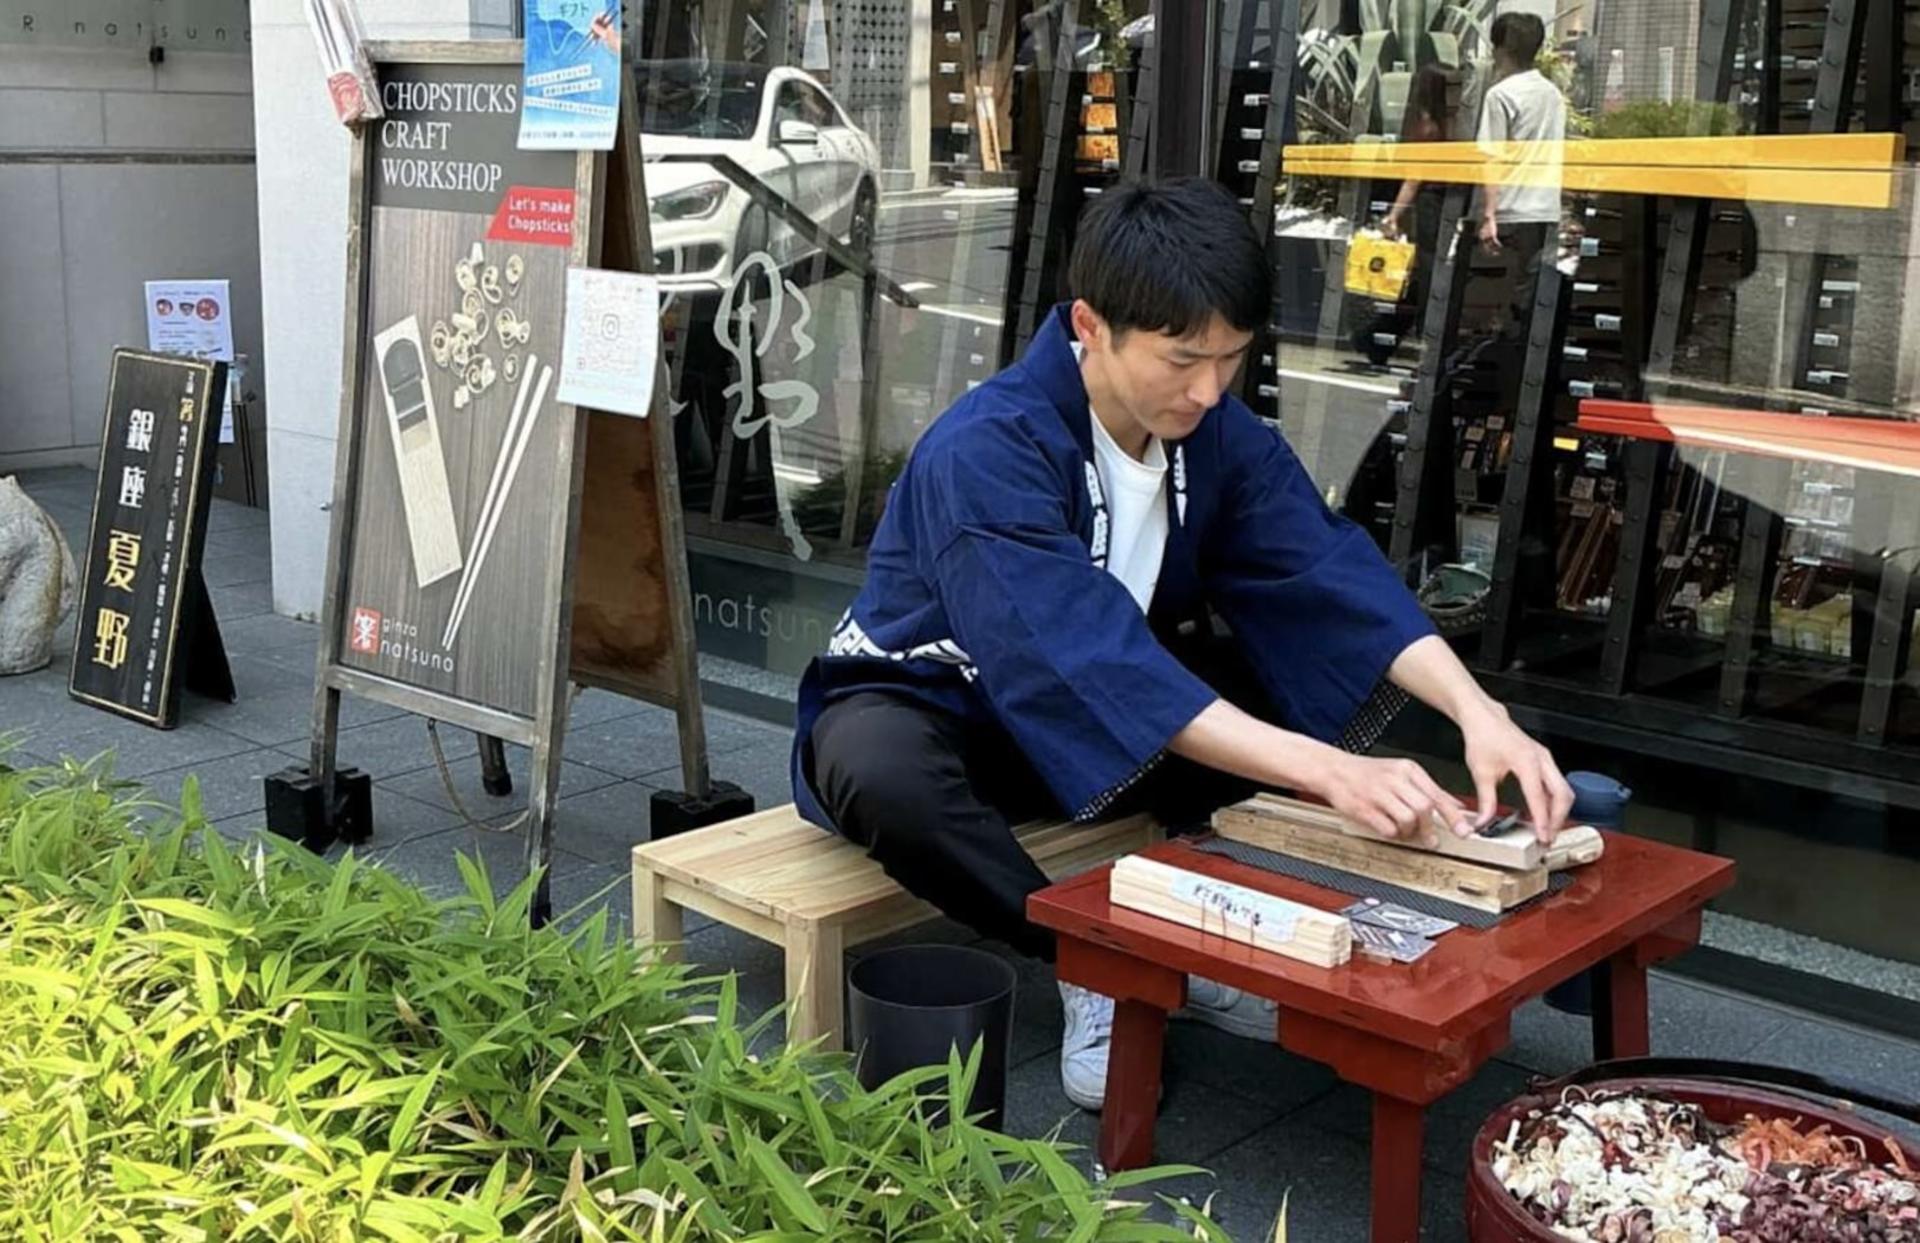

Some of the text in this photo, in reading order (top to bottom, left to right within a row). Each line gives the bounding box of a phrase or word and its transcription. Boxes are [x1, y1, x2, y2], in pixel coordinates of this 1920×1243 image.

[383, 82, 517, 113] CHOPSTICKS
[381, 120, 451, 150] CRAFT
[381, 157, 502, 192] WORKSHOP
[509, 196, 571, 214] Let's make
[92, 408, 154, 669] 銀座夏野
[382, 617, 417, 637] ginza
[695, 592, 828, 647] natsun
[381, 639, 454, 672] natsuno
